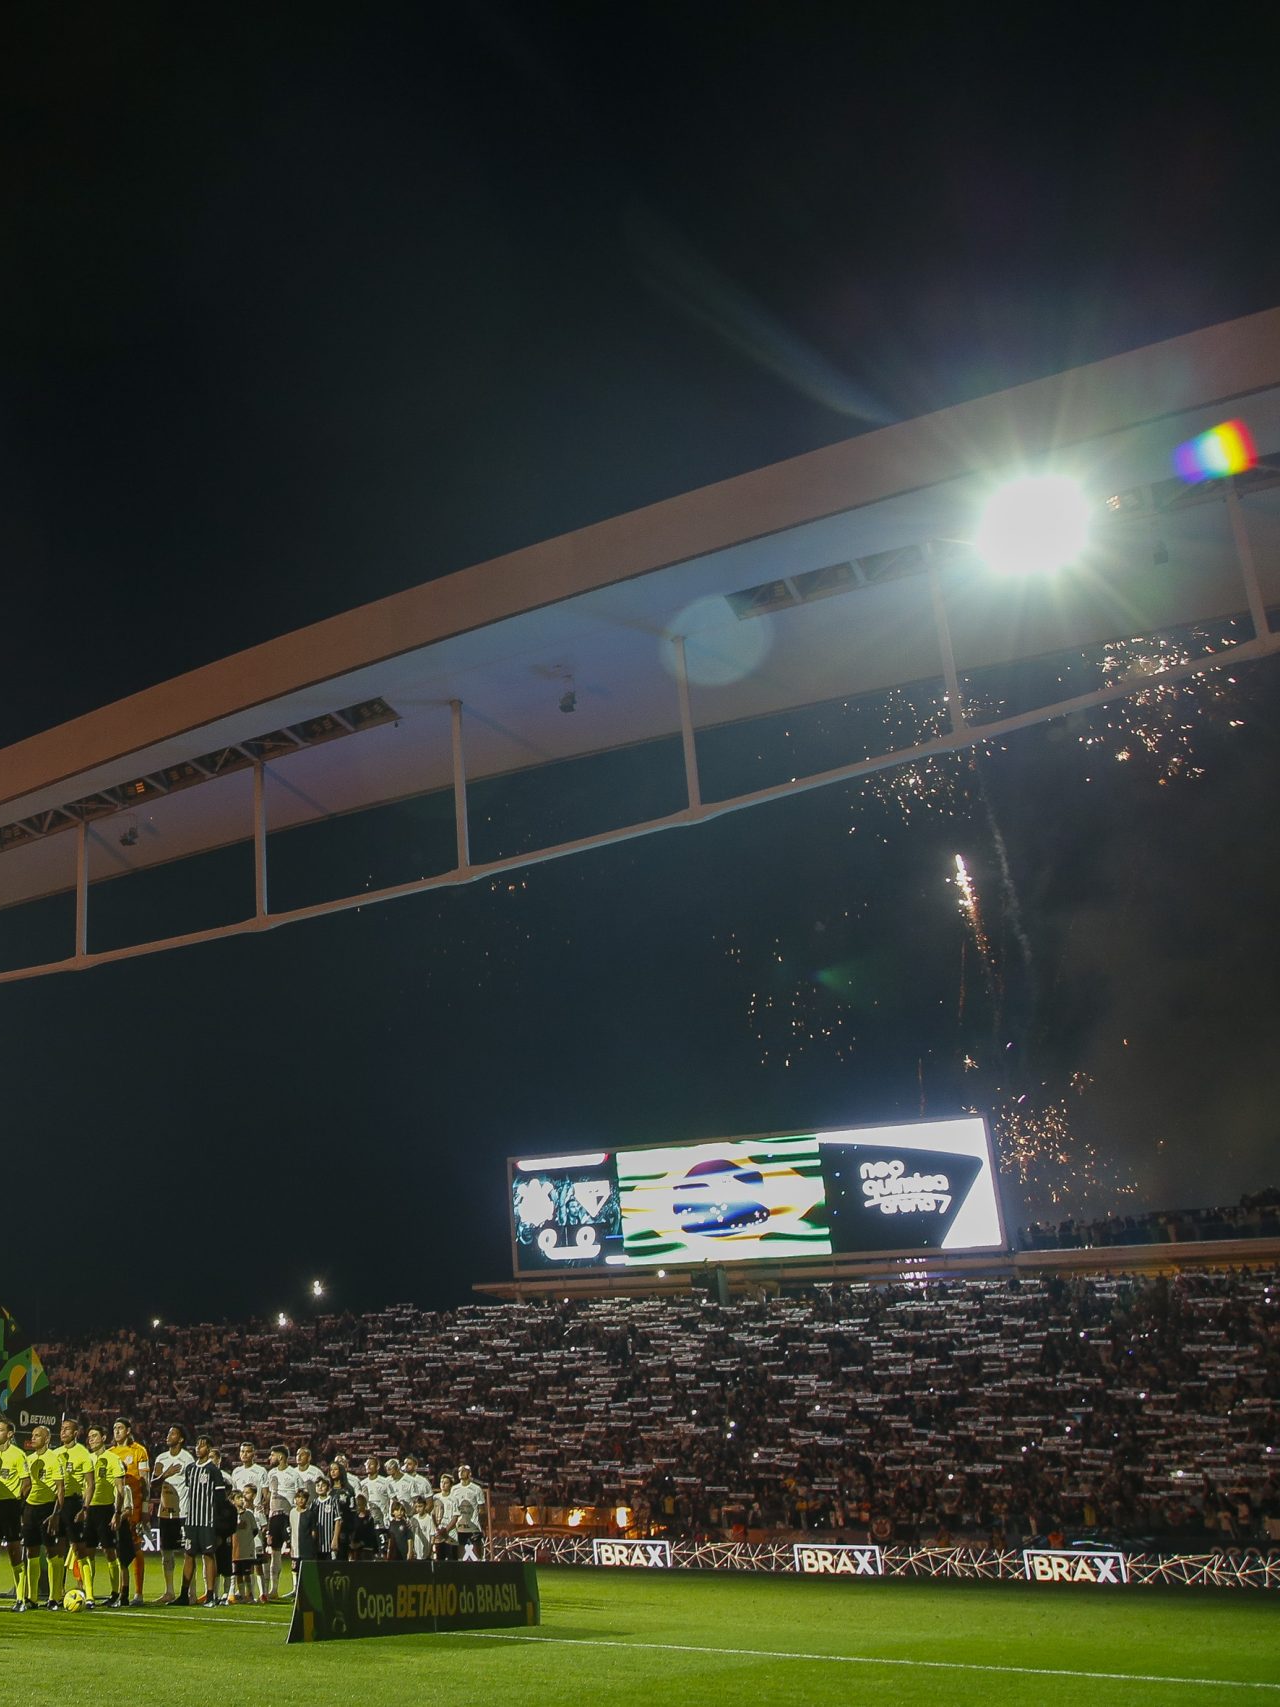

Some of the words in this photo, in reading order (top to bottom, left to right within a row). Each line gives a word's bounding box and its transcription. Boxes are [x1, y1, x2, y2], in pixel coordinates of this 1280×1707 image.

[30, 1414, 57, 1426] BETANO
[601, 1546, 664, 1567] BRAX
[803, 1550, 876, 1575] BRAX
[1034, 1557, 1118, 1584] BRAX
[357, 1587, 395, 1624] Copa
[397, 1583, 456, 1618] BETANO
[459, 1585, 476, 1614] do
[476, 1583, 522, 1613] BRASIL
